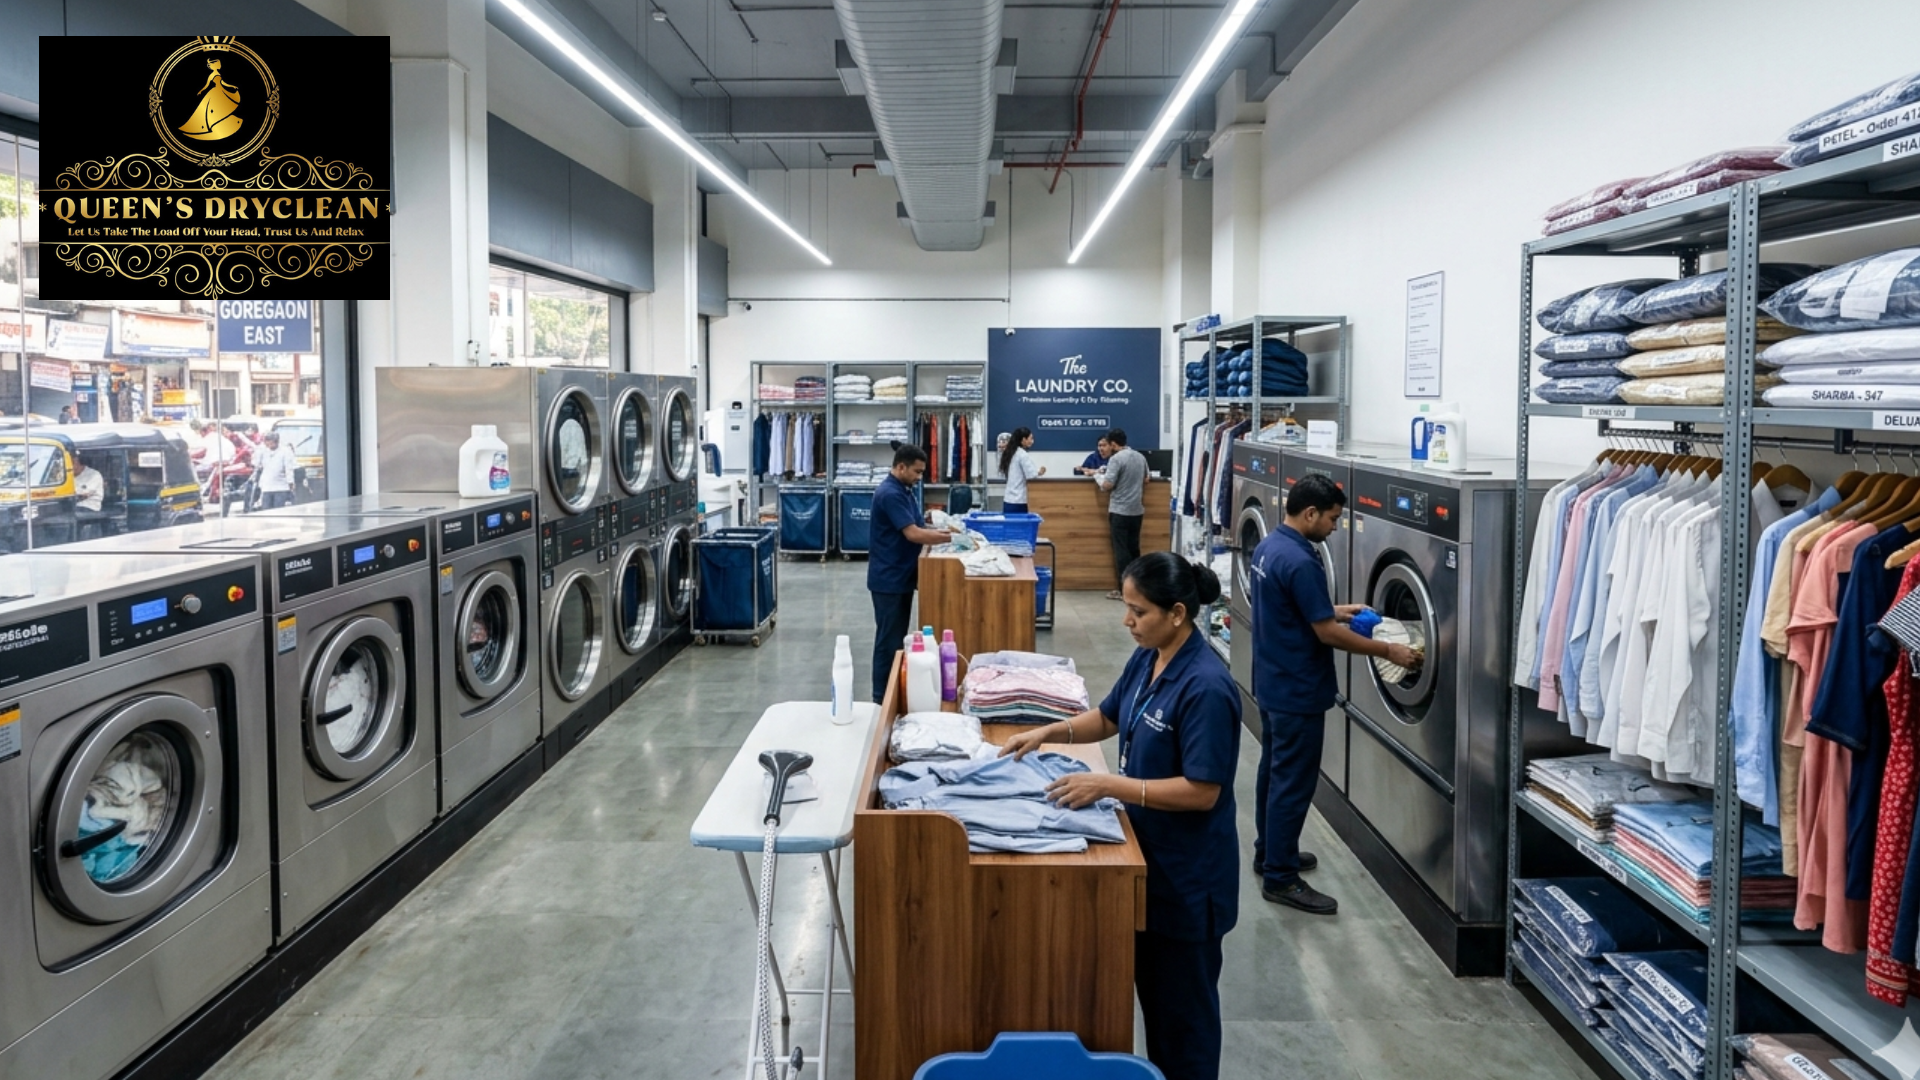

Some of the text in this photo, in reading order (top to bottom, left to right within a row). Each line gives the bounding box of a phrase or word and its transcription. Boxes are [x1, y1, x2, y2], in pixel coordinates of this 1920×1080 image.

[1891, 137, 1920, 156] SHA
[220, 300, 307, 319] GOREGAON
[244, 326, 285, 345] EAST
[1059, 354, 1088, 375] The
[1015, 379, 1133, 393] LAUNDRY CO.
[1864, 390, 1884, 401] 347
